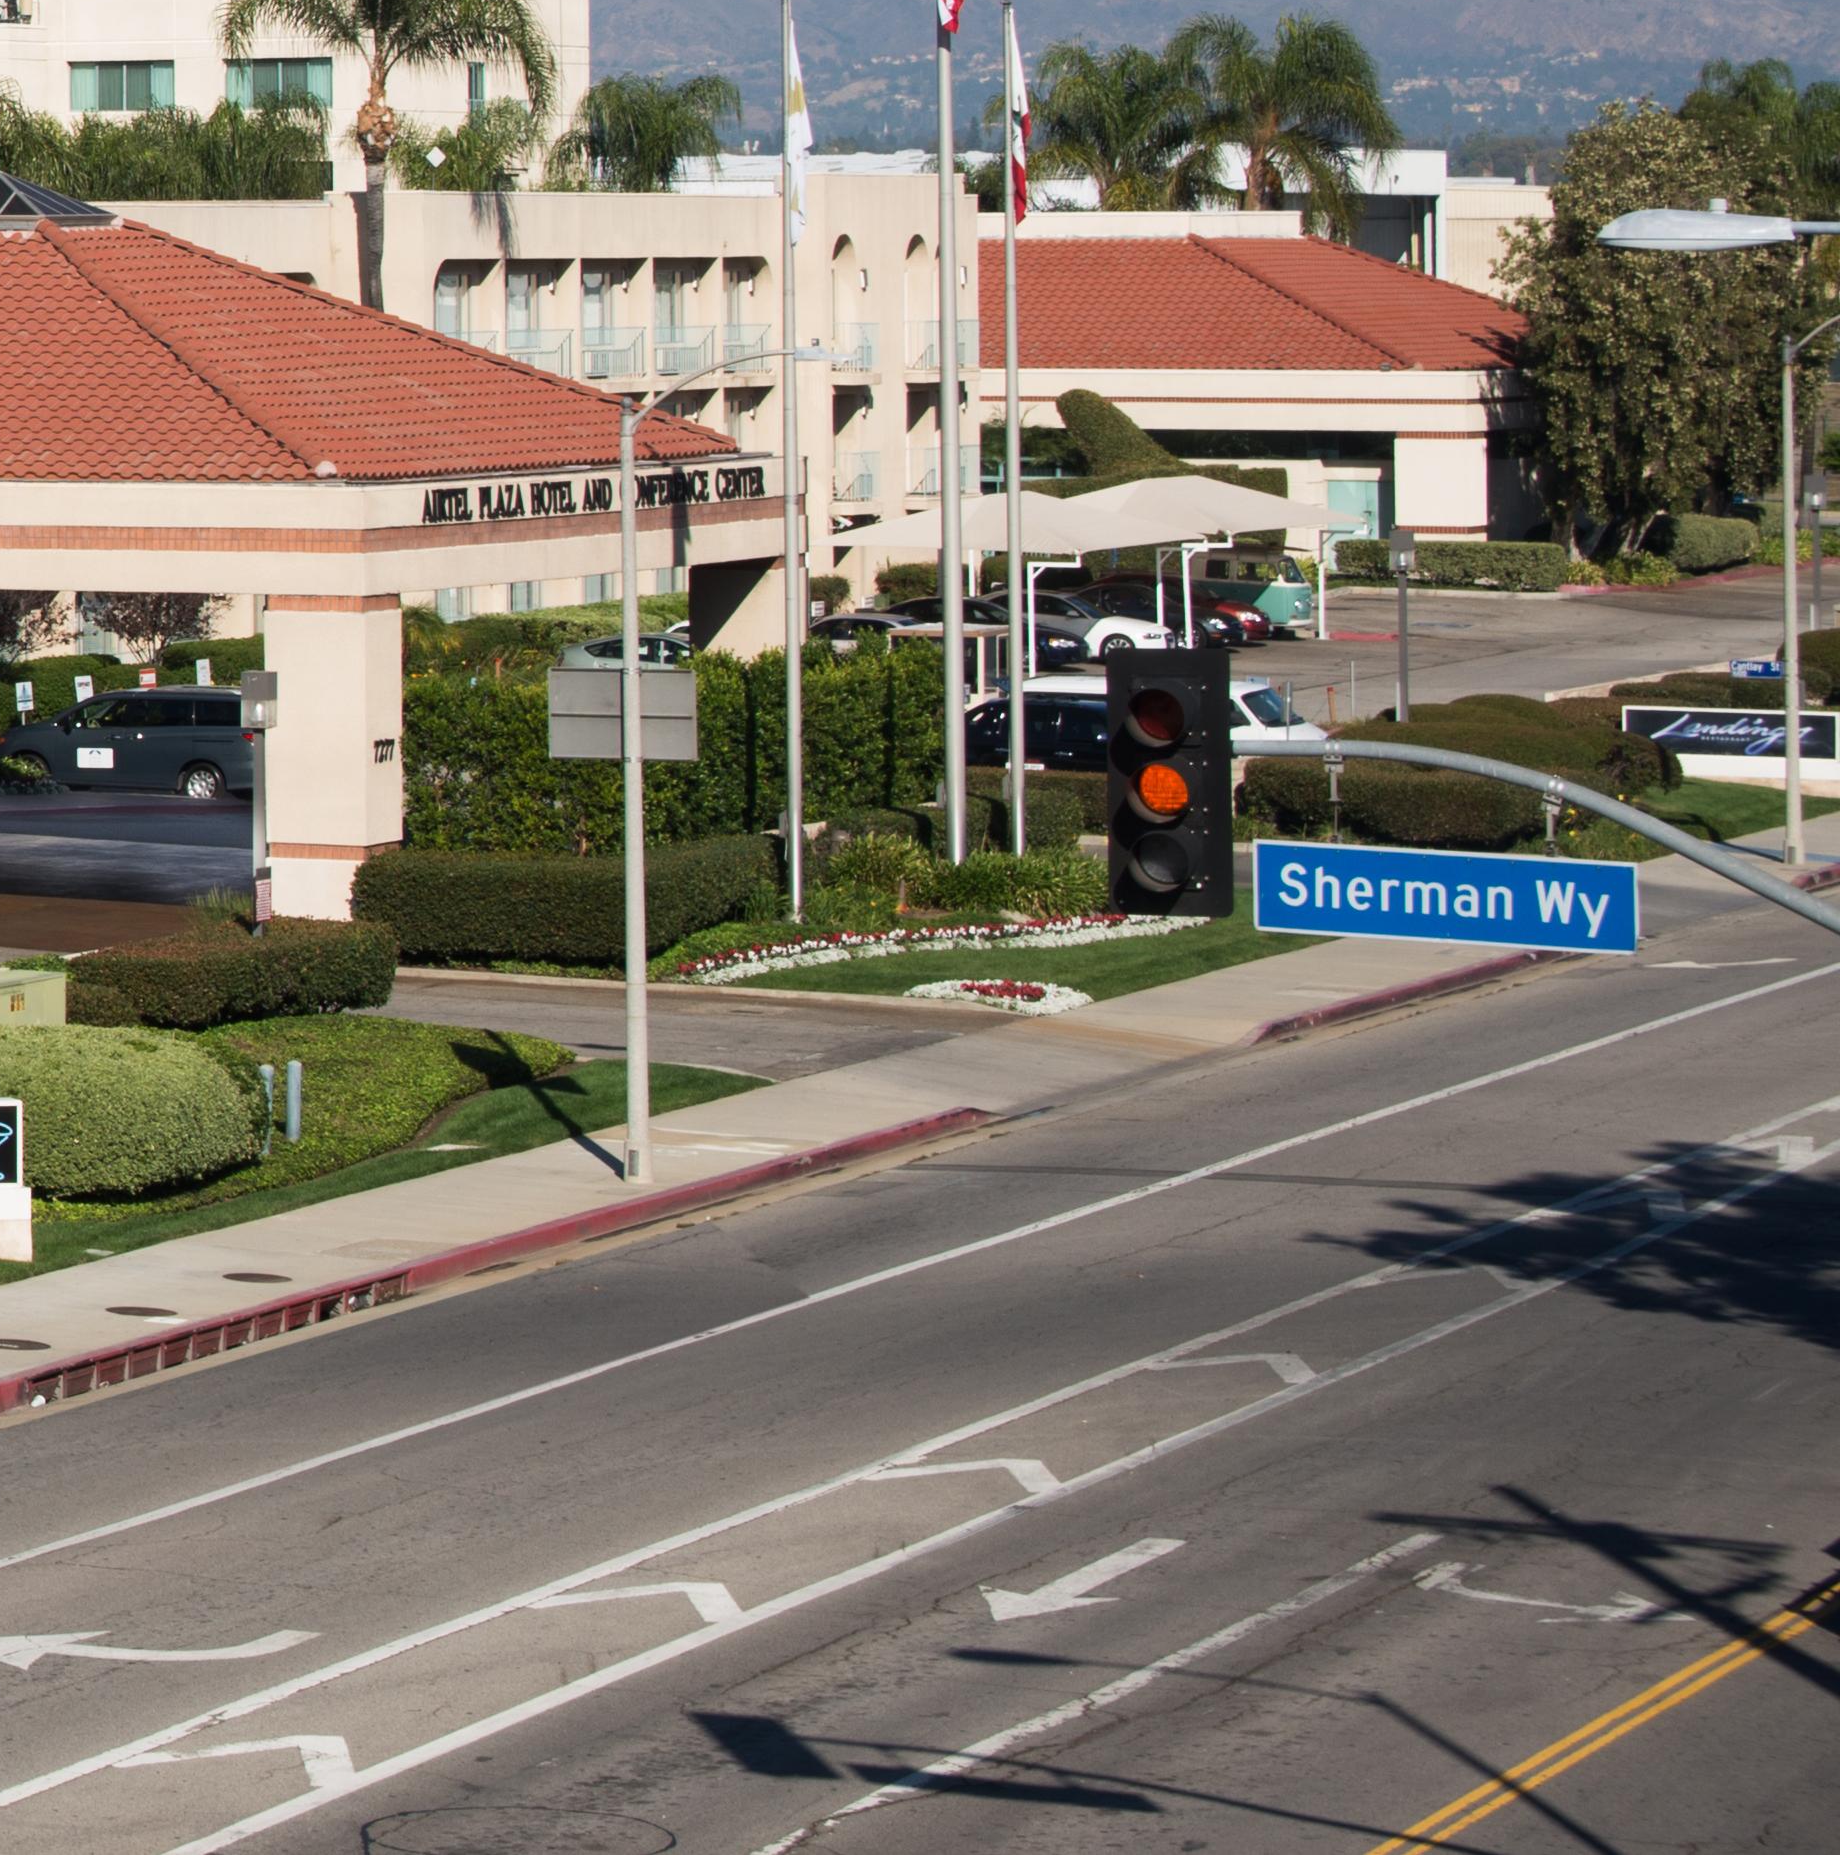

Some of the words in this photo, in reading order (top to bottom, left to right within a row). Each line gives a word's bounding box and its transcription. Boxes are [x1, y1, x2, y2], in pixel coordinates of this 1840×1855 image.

[422, 487, 473, 524] AIRTEL
[478, 483, 525, 520] PLAZA
[530, 480, 576, 516] HOTEL
[582, 477, 613, 512] AND
[715, 466, 766, 501] CENTER
[1770, 660, 1780, 672] St
[1278, 861, 1513, 921] Sherman
[1535, 879, 1610, 938] Wy
